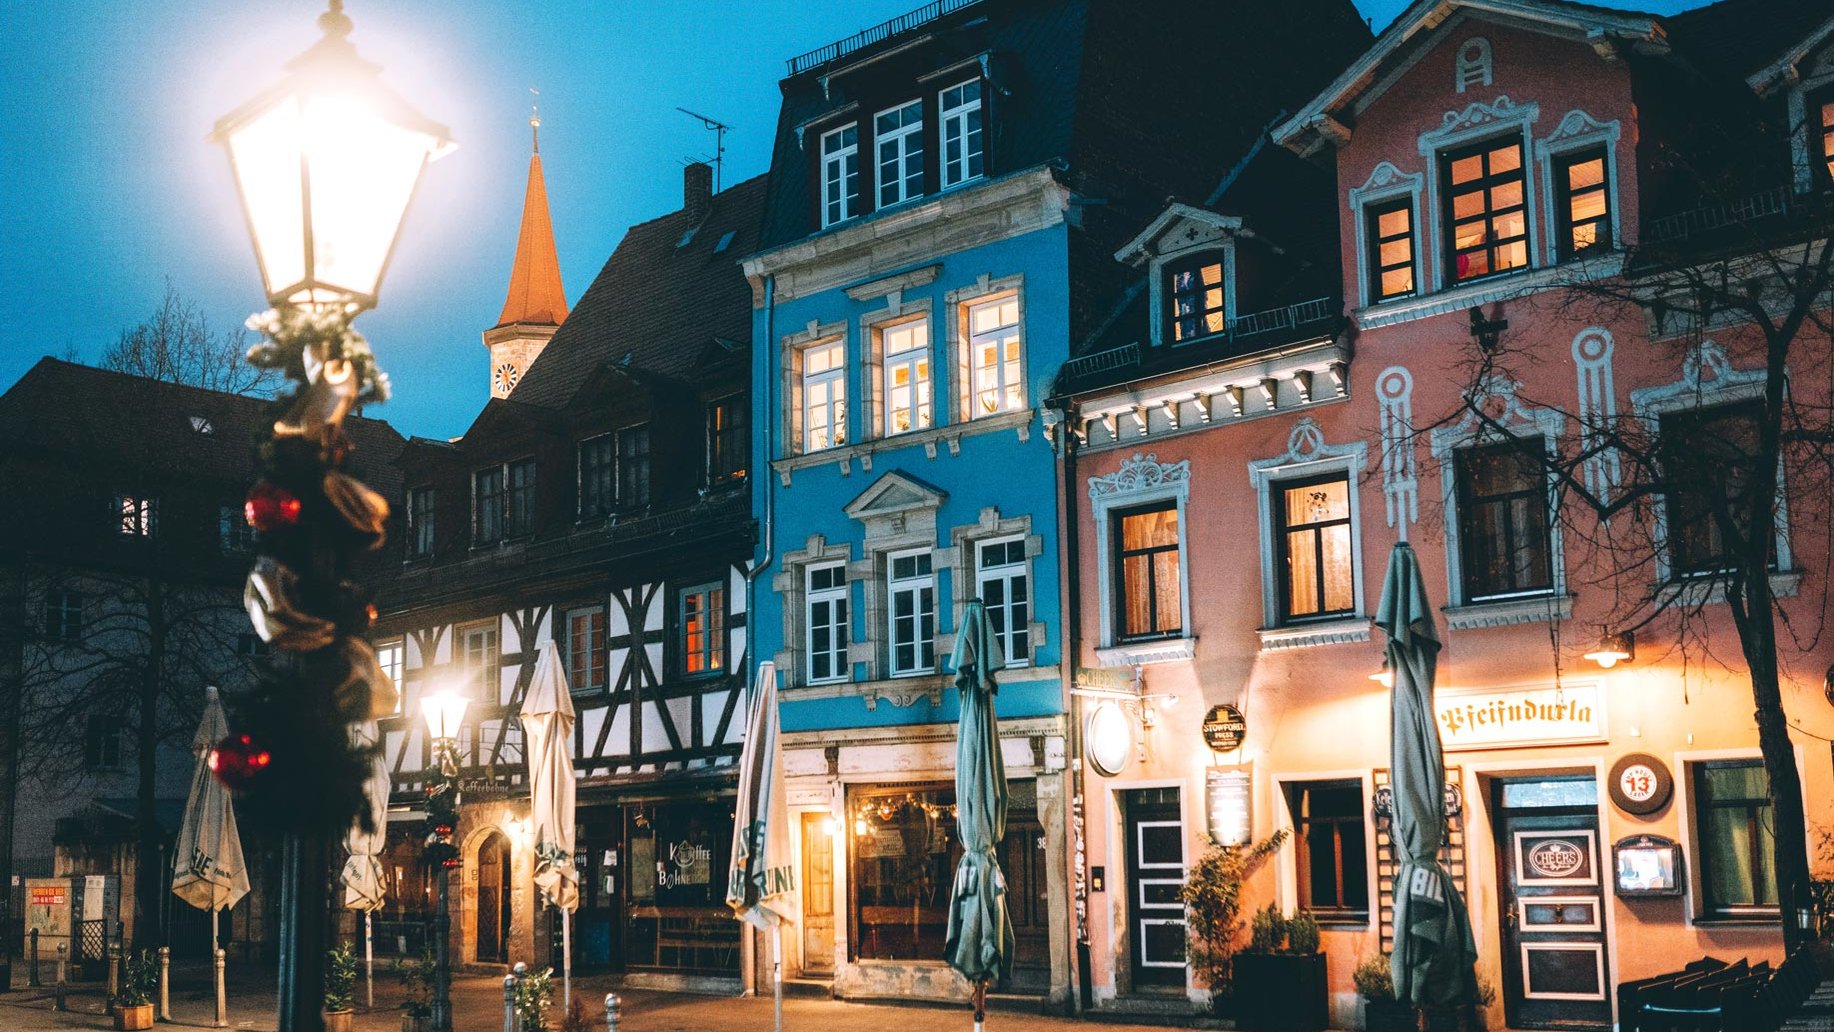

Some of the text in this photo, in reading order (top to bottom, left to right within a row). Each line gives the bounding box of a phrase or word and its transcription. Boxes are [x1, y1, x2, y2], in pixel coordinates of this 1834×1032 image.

[1203, 723, 1244, 732] STOWFORD
[1629, 777, 1649, 792] 13
[1534, 851, 1577, 866] CHEERS
